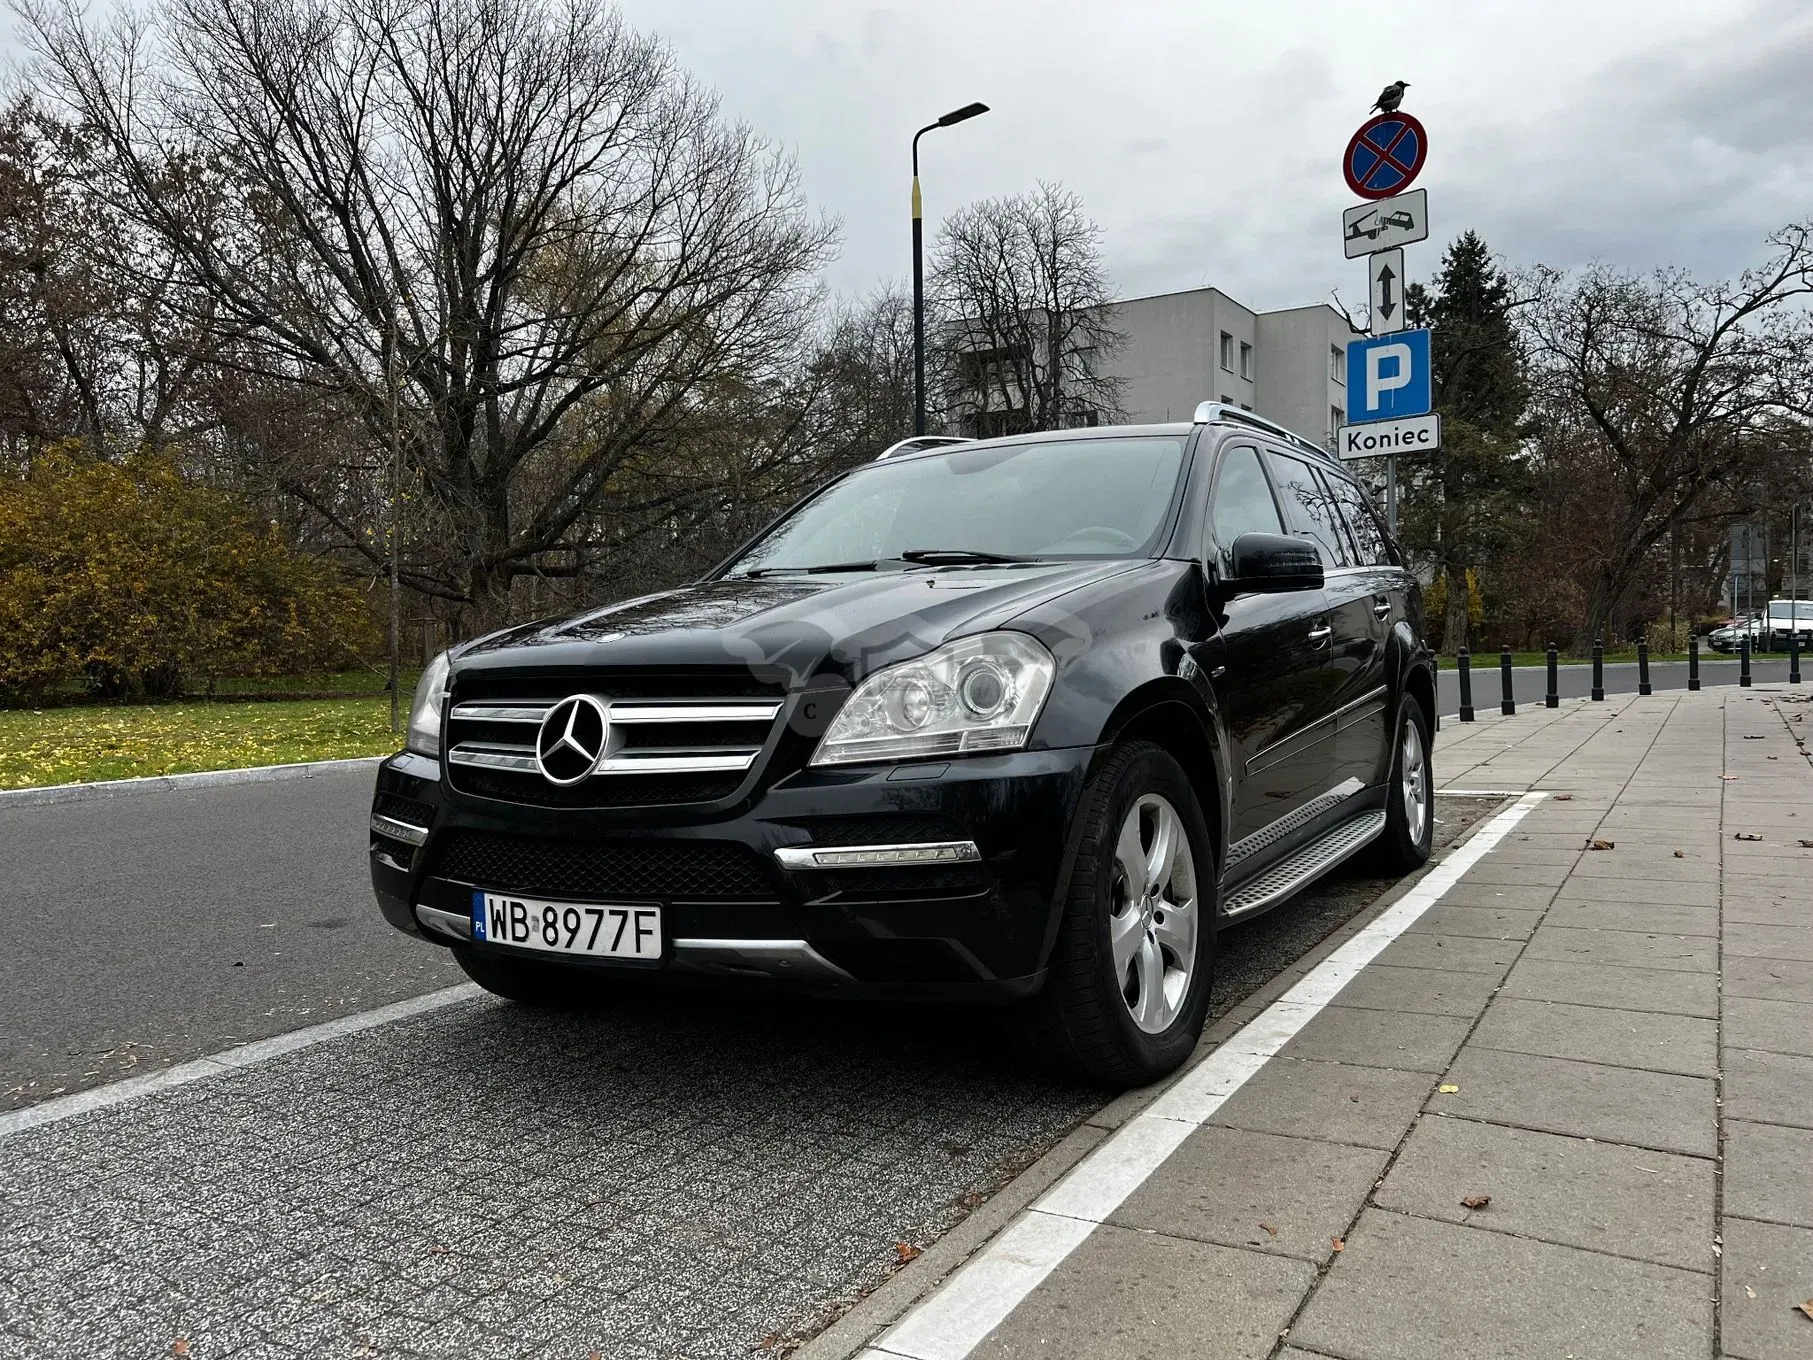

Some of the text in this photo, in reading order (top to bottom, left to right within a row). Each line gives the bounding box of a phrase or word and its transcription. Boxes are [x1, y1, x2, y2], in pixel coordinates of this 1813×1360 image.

[1366, 343, 1412, 412] P
[1348, 426, 1430, 452] Koniec
[475, 920, 485, 933] PL
[489, 898, 657, 954] WB 8977F
